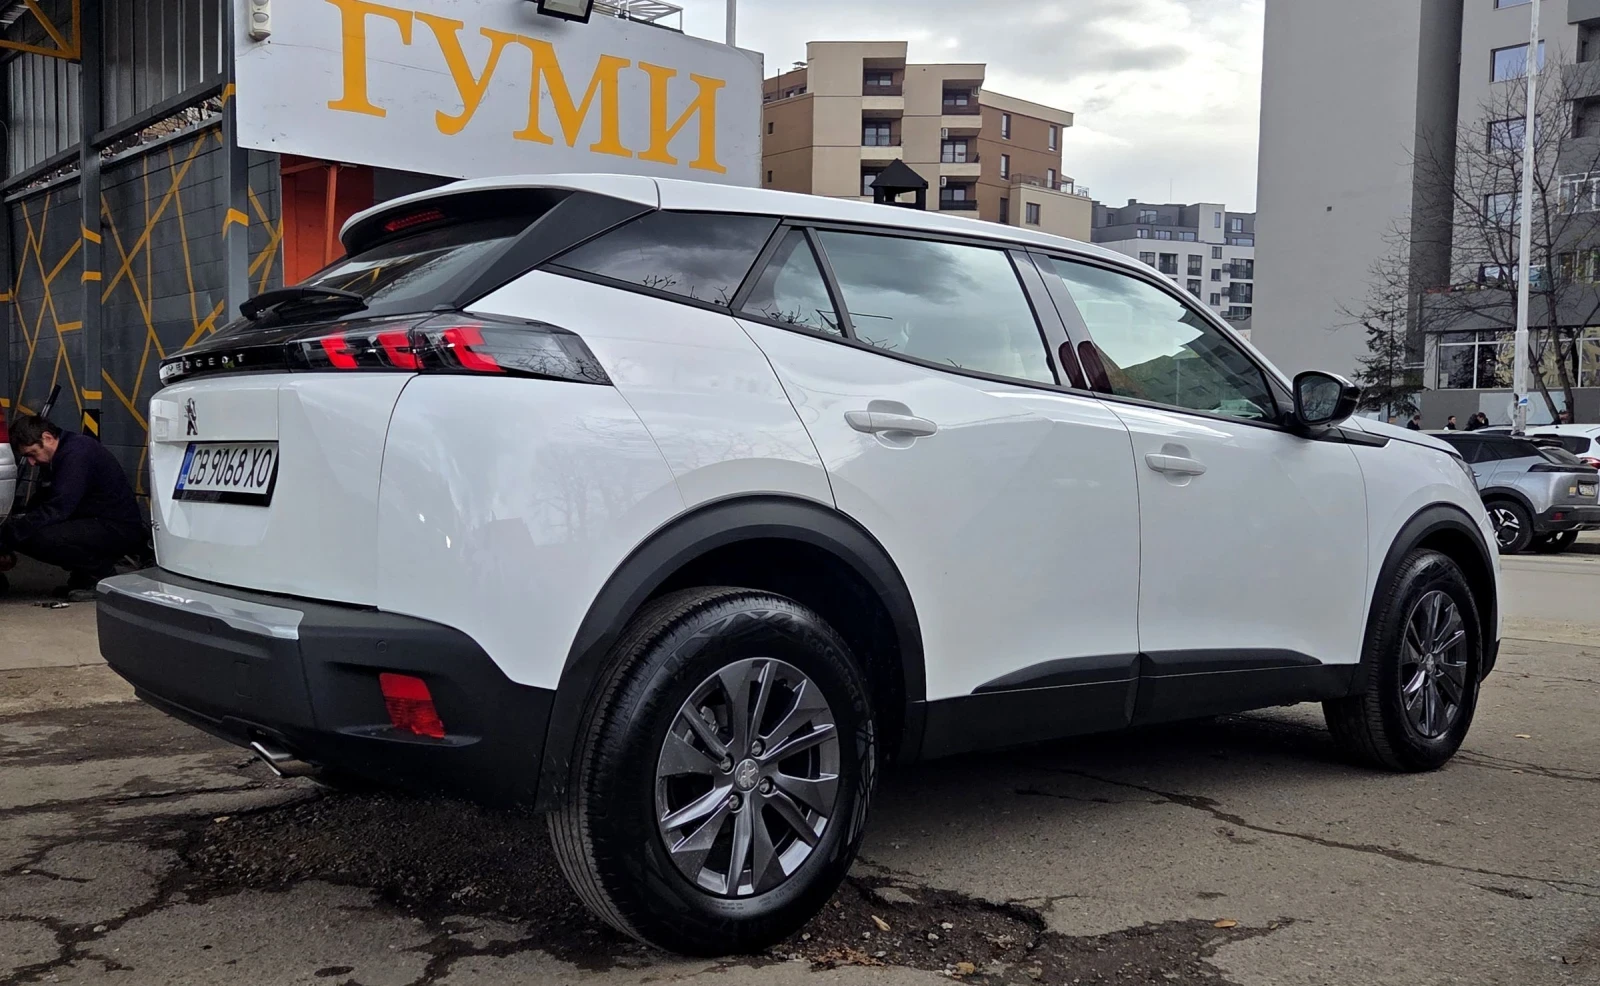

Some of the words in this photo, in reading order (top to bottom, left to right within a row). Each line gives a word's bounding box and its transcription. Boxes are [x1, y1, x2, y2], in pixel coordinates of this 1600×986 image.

[326, 0, 727, 174] ГУМИ
[187, 448, 210, 485] CB
[207, 447, 248, 486] 9068
[243, 447, 273, 488] XO
